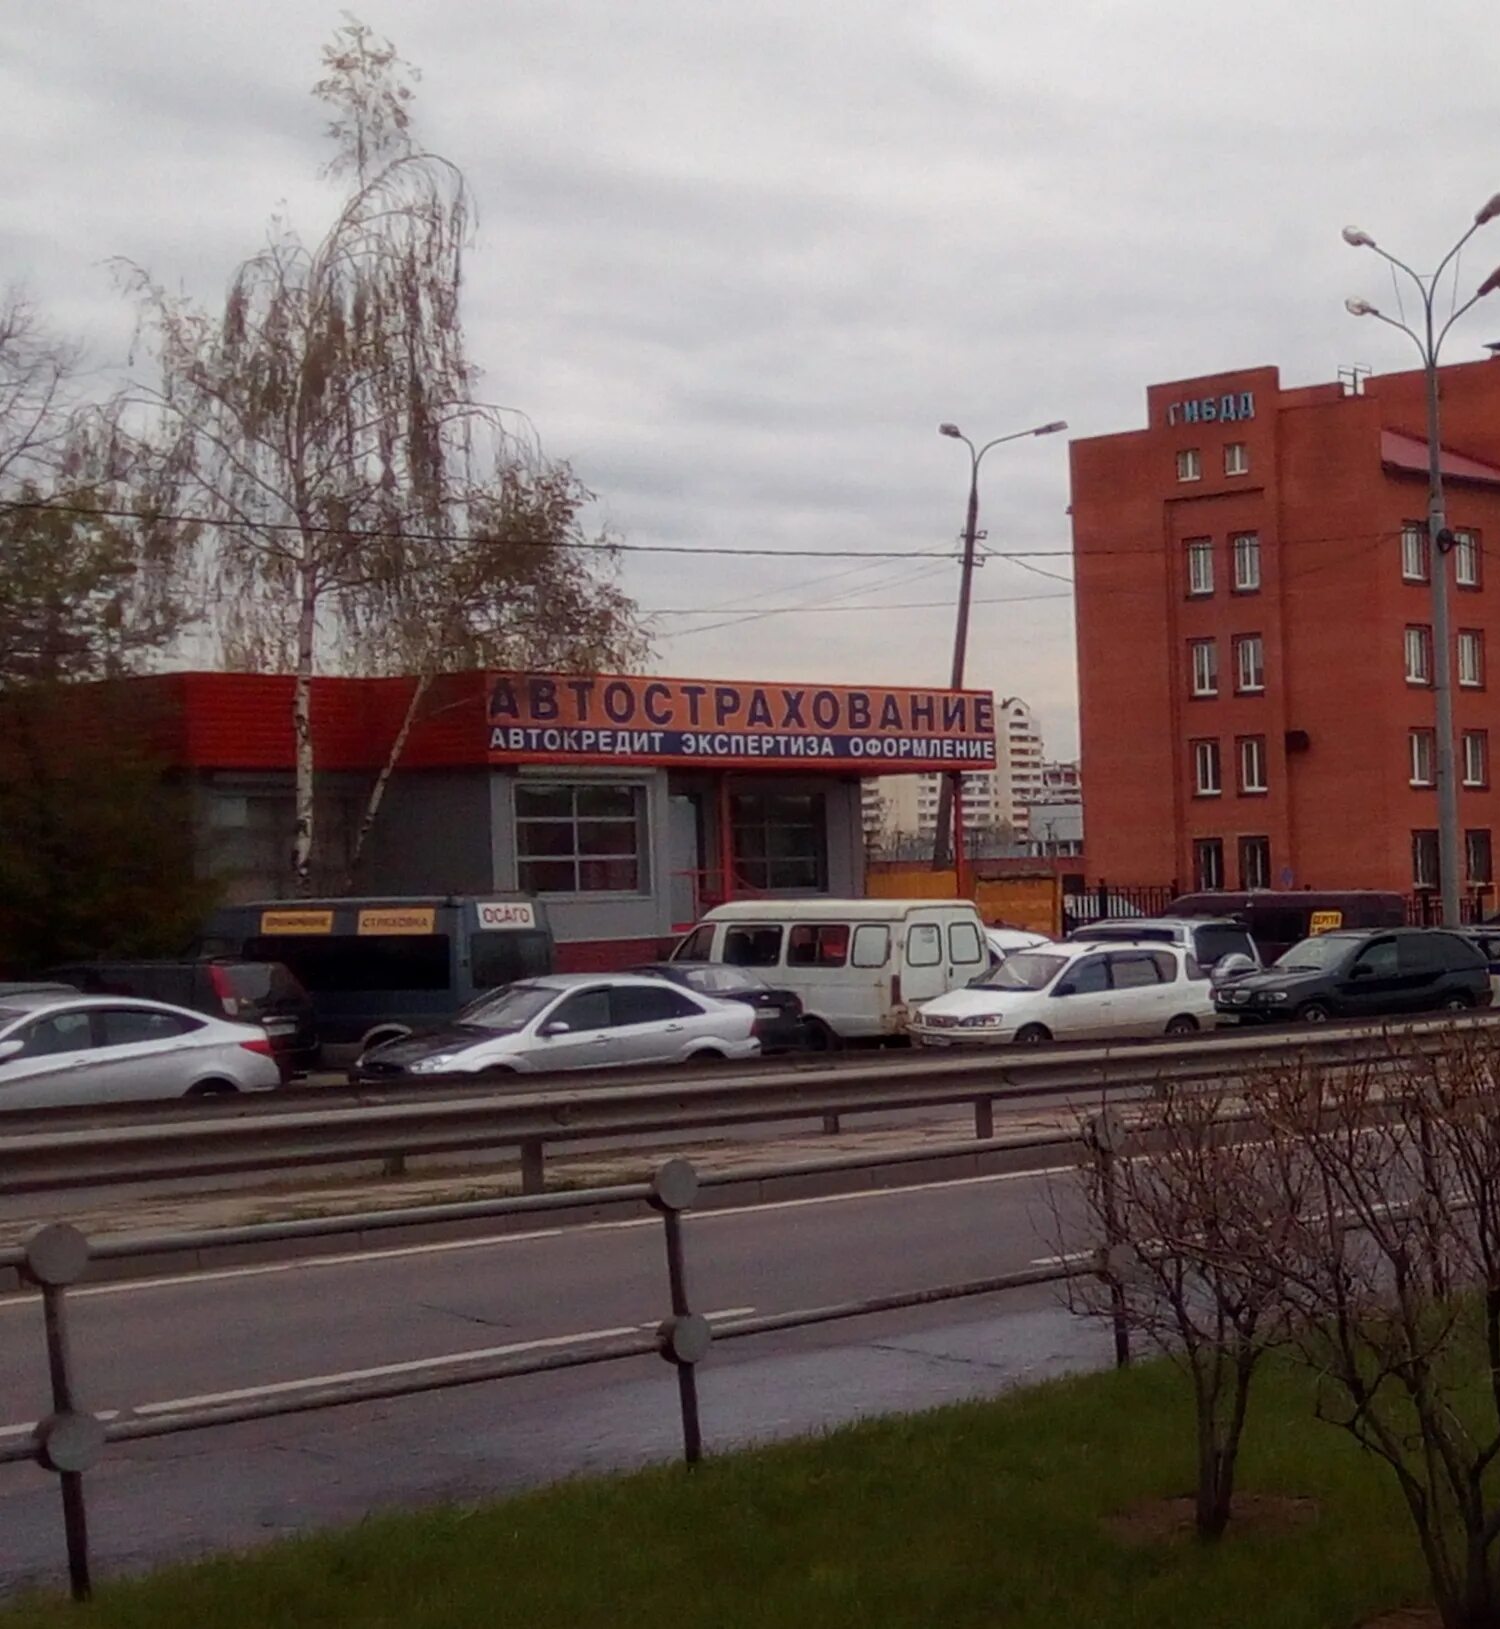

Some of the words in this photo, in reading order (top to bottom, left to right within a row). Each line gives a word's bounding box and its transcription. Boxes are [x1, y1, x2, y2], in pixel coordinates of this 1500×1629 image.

[1168, 392, 1254, 426] ГИБДД
[488, 677, 995, 734] АВТОСТРАХОВАНИЕ
[489, 727, 665, 755] АВТОКРЕДИТ
[680, 734, 835, 757] ЭКСПЕРТИЗА
[849, 737, 995, 760] ОФОРМЛЕНИЕ
[482, 904, 530, 924] ОСАГО
